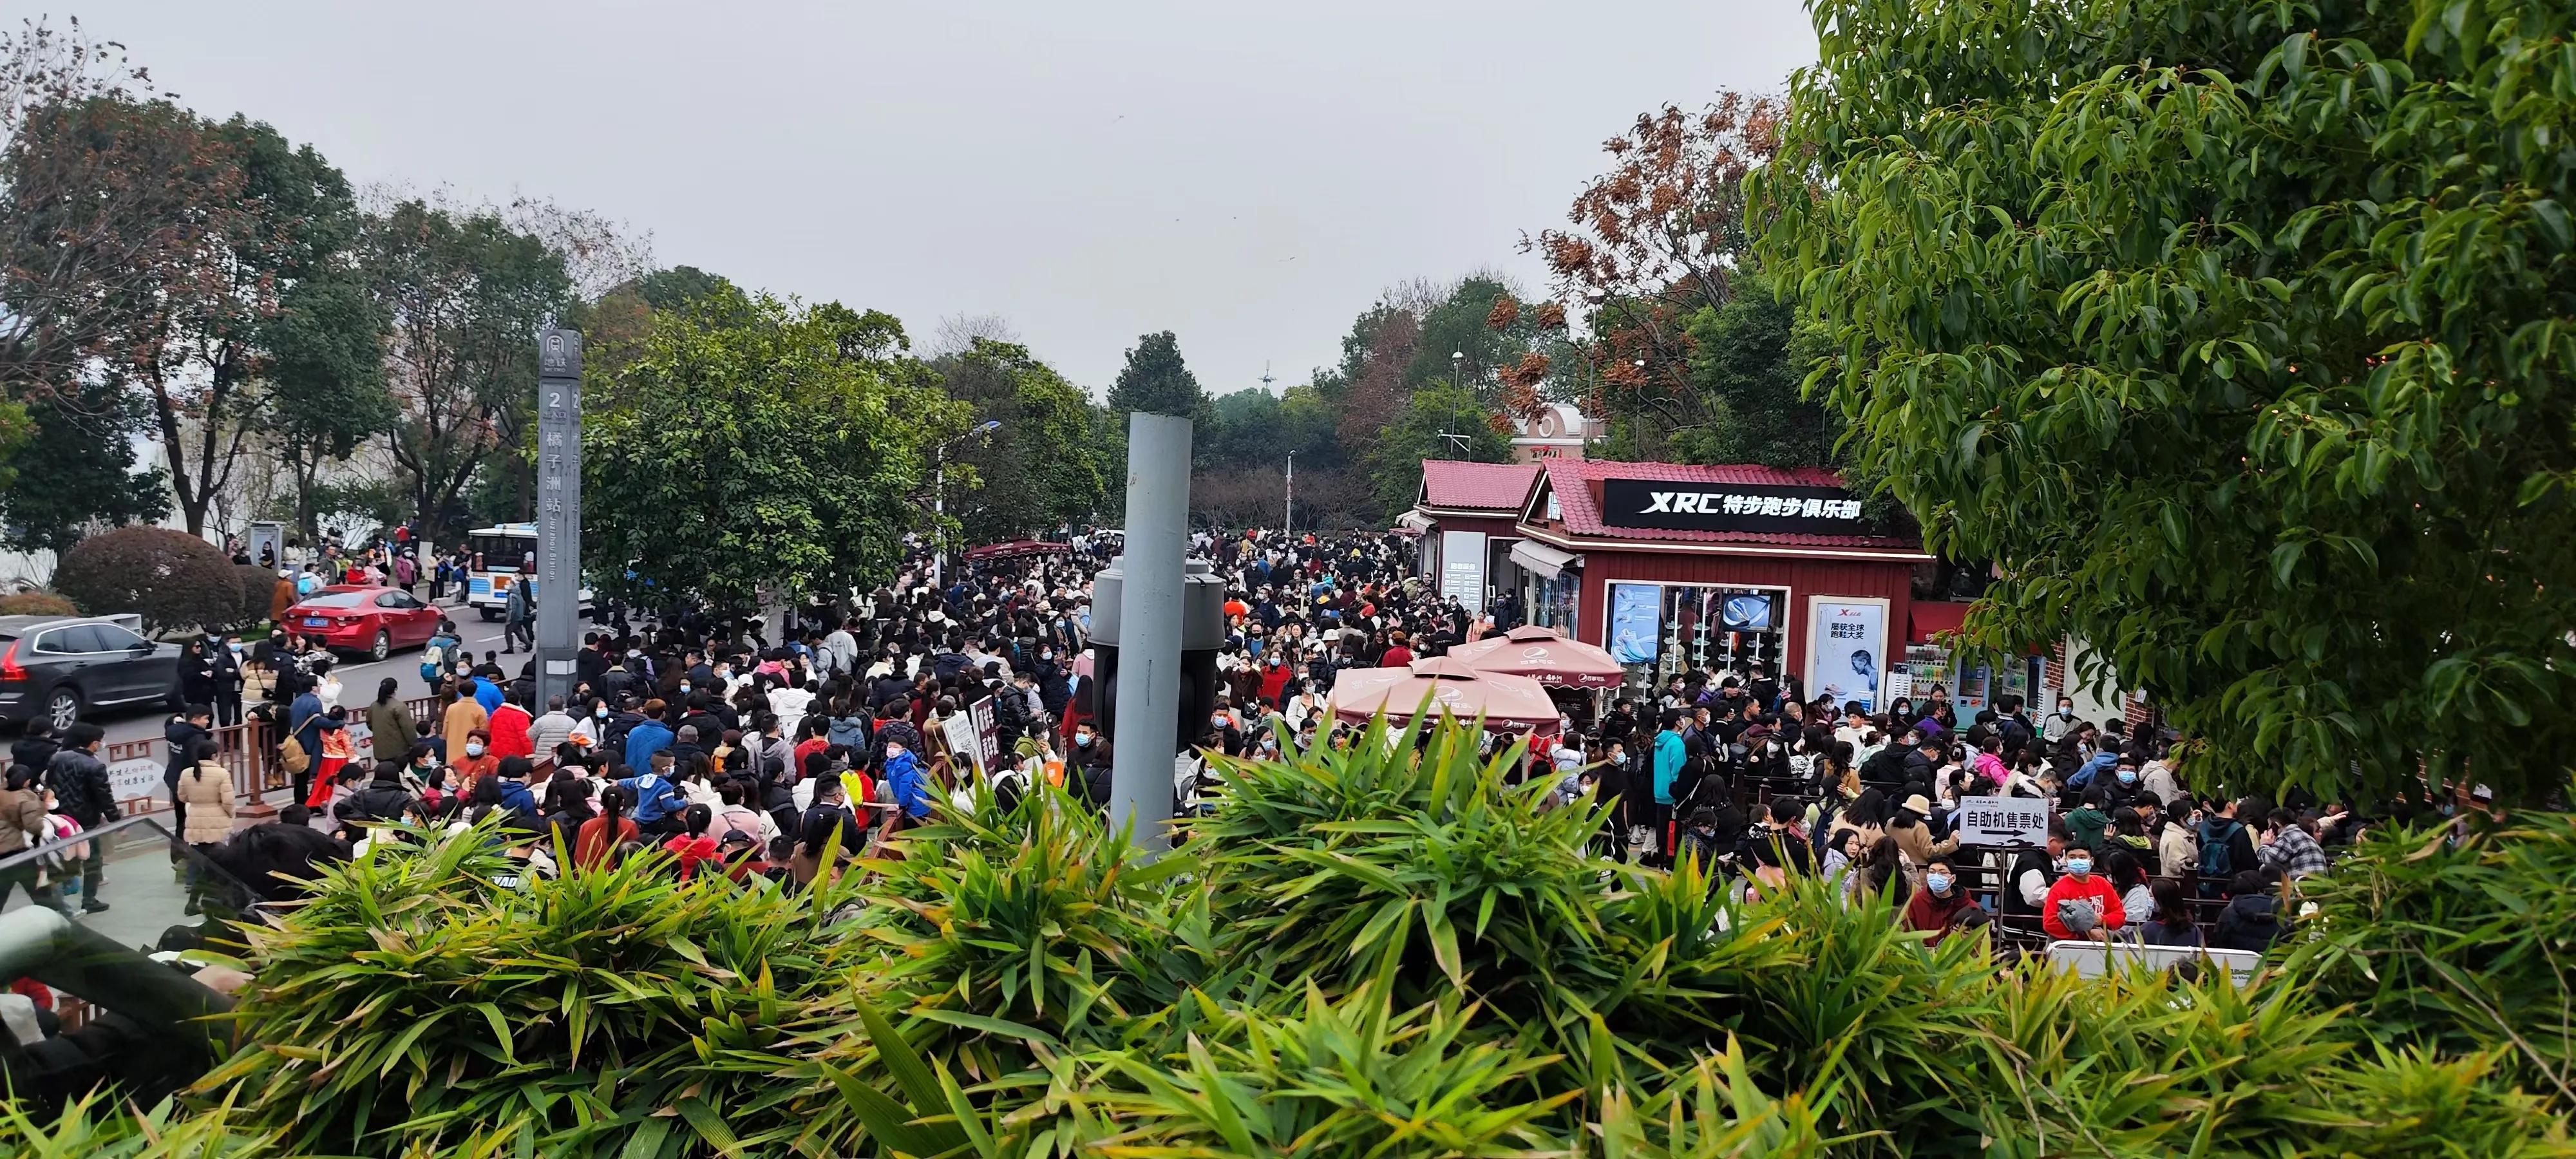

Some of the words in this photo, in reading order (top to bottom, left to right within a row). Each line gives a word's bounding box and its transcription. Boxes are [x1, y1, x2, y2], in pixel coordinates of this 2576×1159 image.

[549, 392, 560, 408] 2
[545, 431, 562, 513] 橘子洲站
[1636, 492, 1723, 514] XRC
[1723, 495, 1861, 520] 特步跑步俱乐部
[1830, 631, 1864, 640] 跑鞋大奖
[1831, 623, 1864, 632] 屡获全球
[1967, 811, 2044, 829] 自助机售票处
